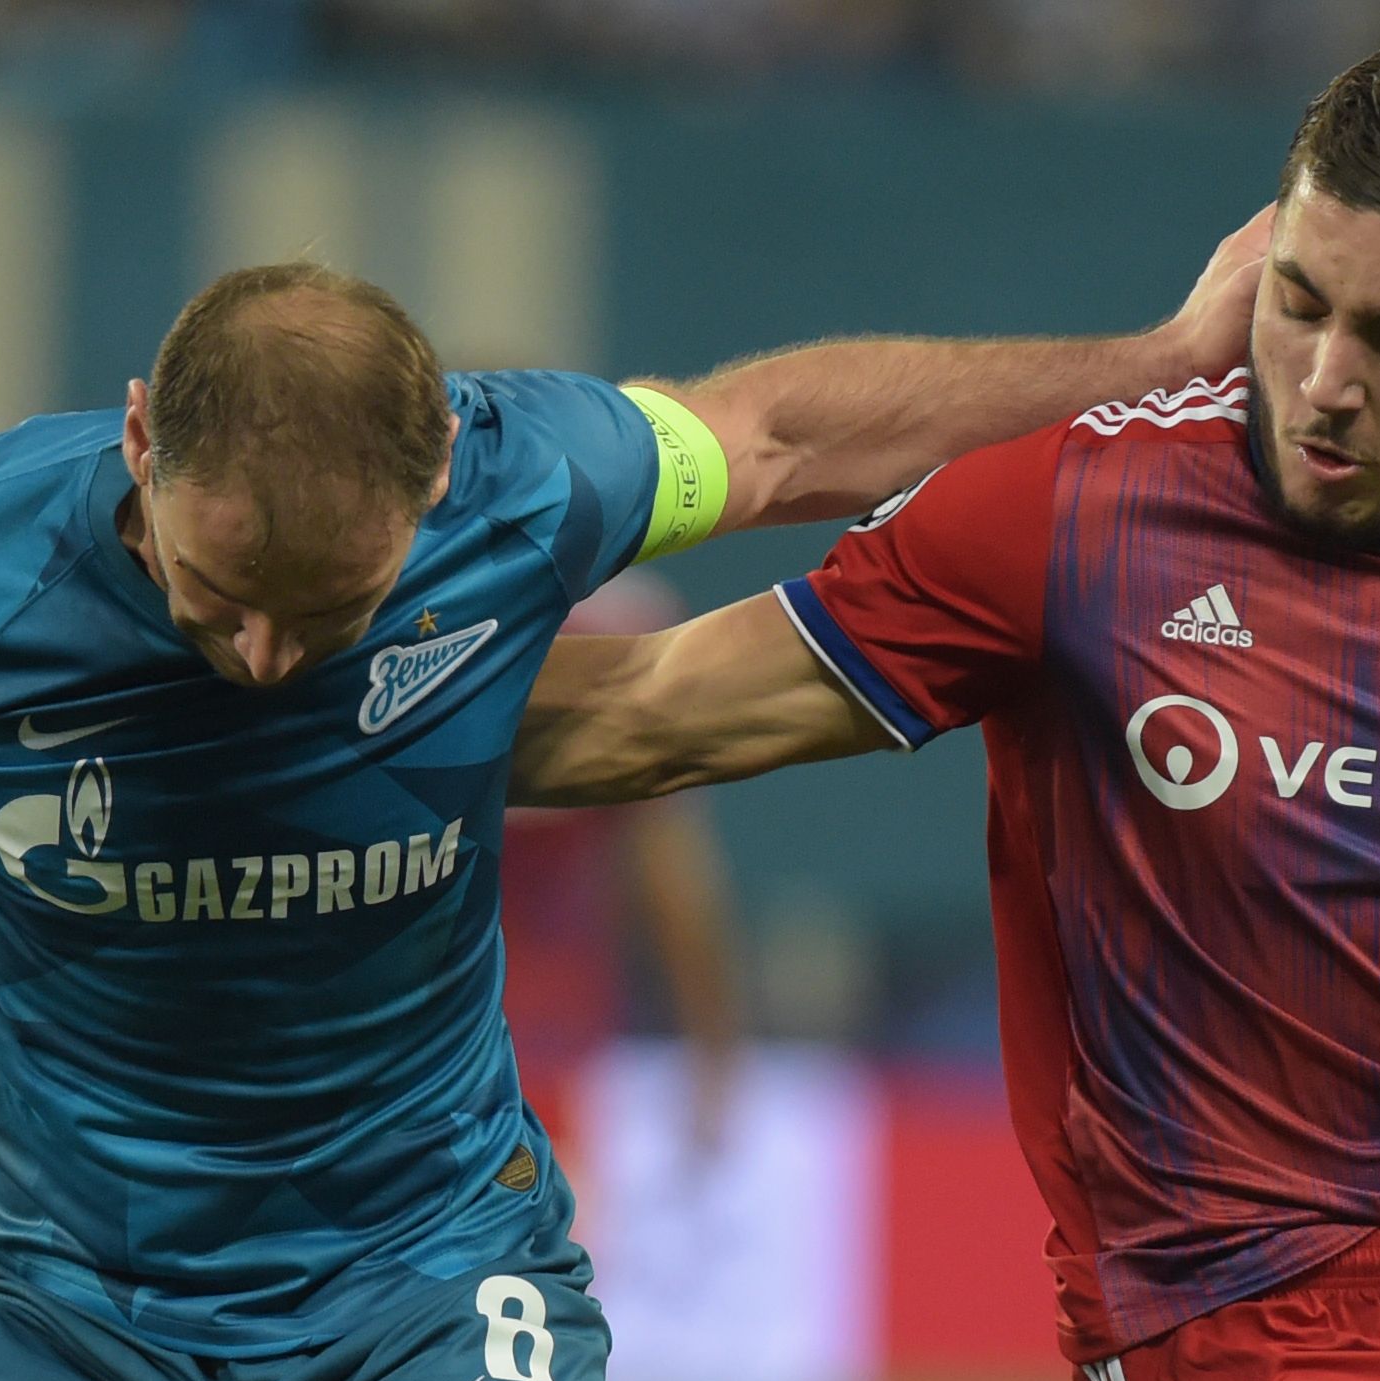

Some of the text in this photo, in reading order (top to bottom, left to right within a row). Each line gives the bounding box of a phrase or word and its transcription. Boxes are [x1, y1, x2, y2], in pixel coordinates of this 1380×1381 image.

[644, 413, 696, 508] RESPEC
[1161, 619, 1254, 648] adidas
[135, 817, 463, 922] GAZPROM
